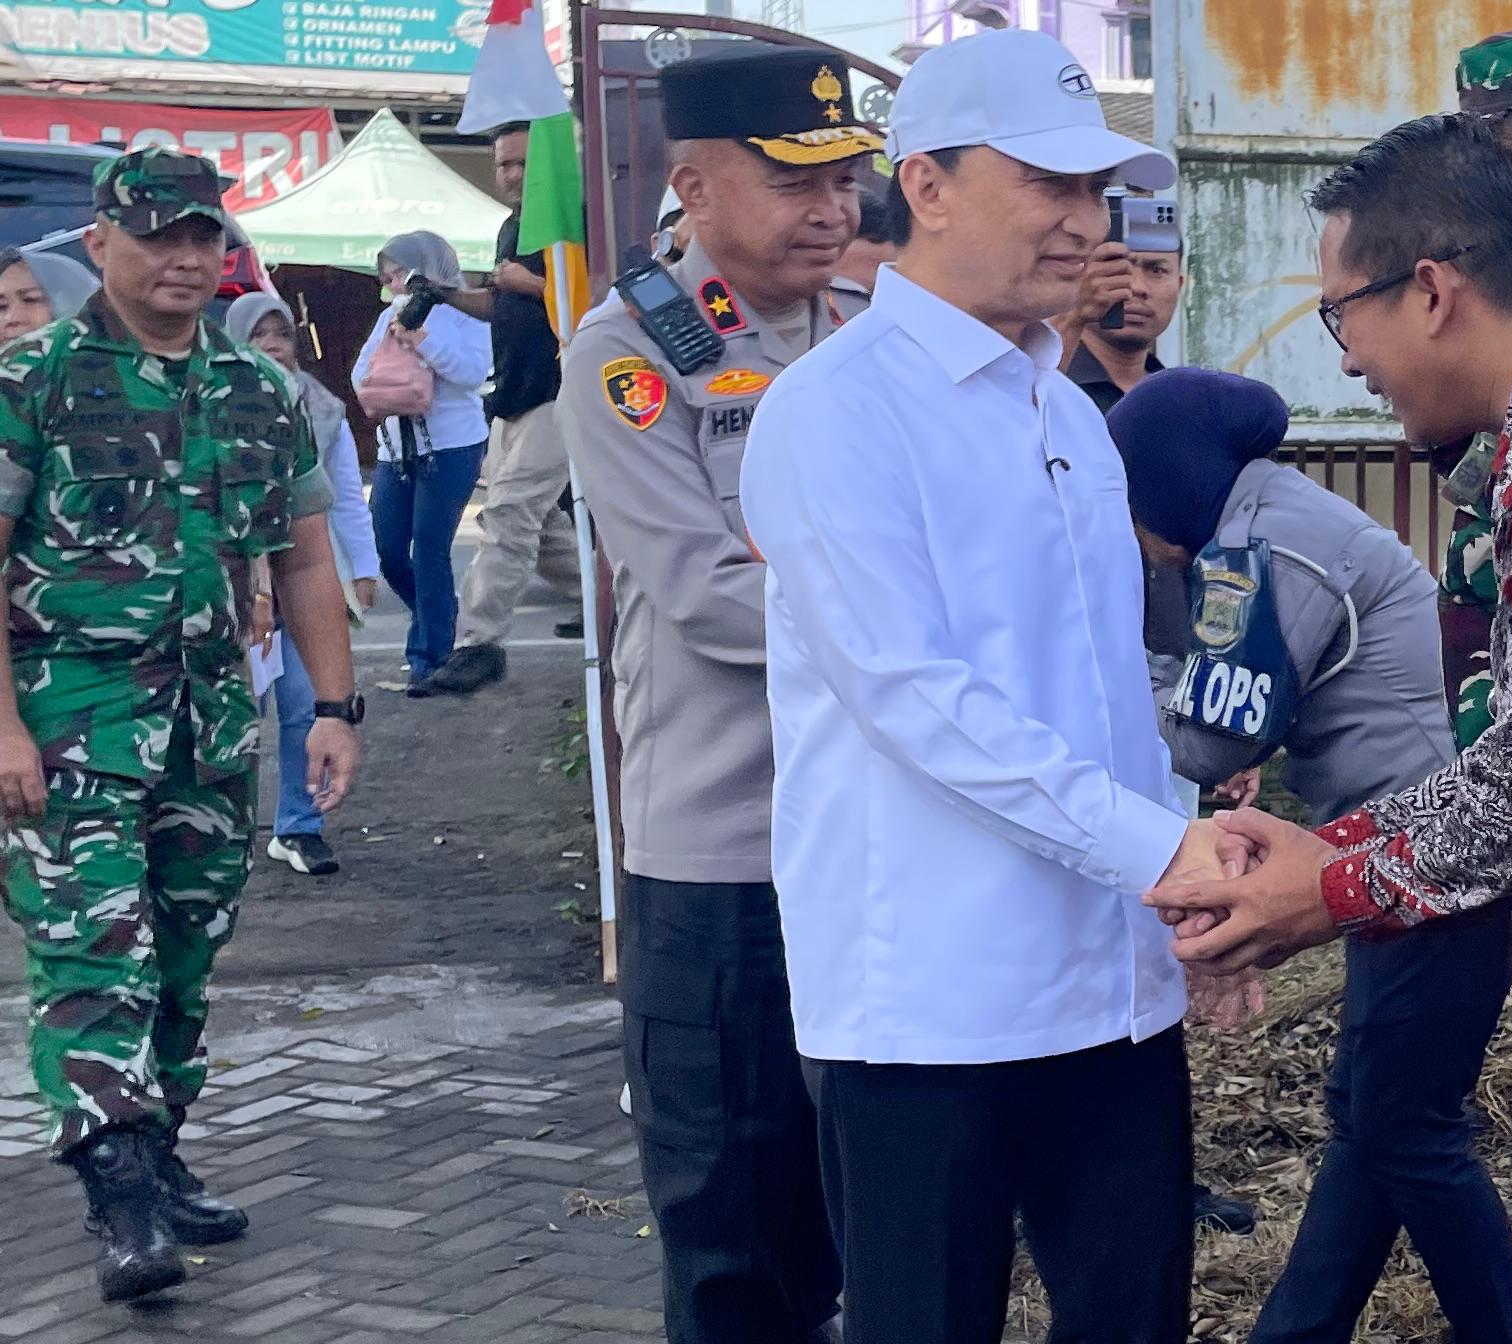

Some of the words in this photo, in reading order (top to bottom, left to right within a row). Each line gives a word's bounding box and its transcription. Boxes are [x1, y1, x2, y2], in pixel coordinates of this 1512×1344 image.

[302, 2, 354, 17] BAJA
[359, 5, 437, 22] RINGAN
[302, 18, 403, 35] ORNAMEN
[303, 35, 384, 51] FITTING
[388, 39, 457, 55] LAMPU
[304, 51, 349, 66] LIST
[353, 54, 416, 68] MOTIF
[1202, 661, 1272, 736] OPS
